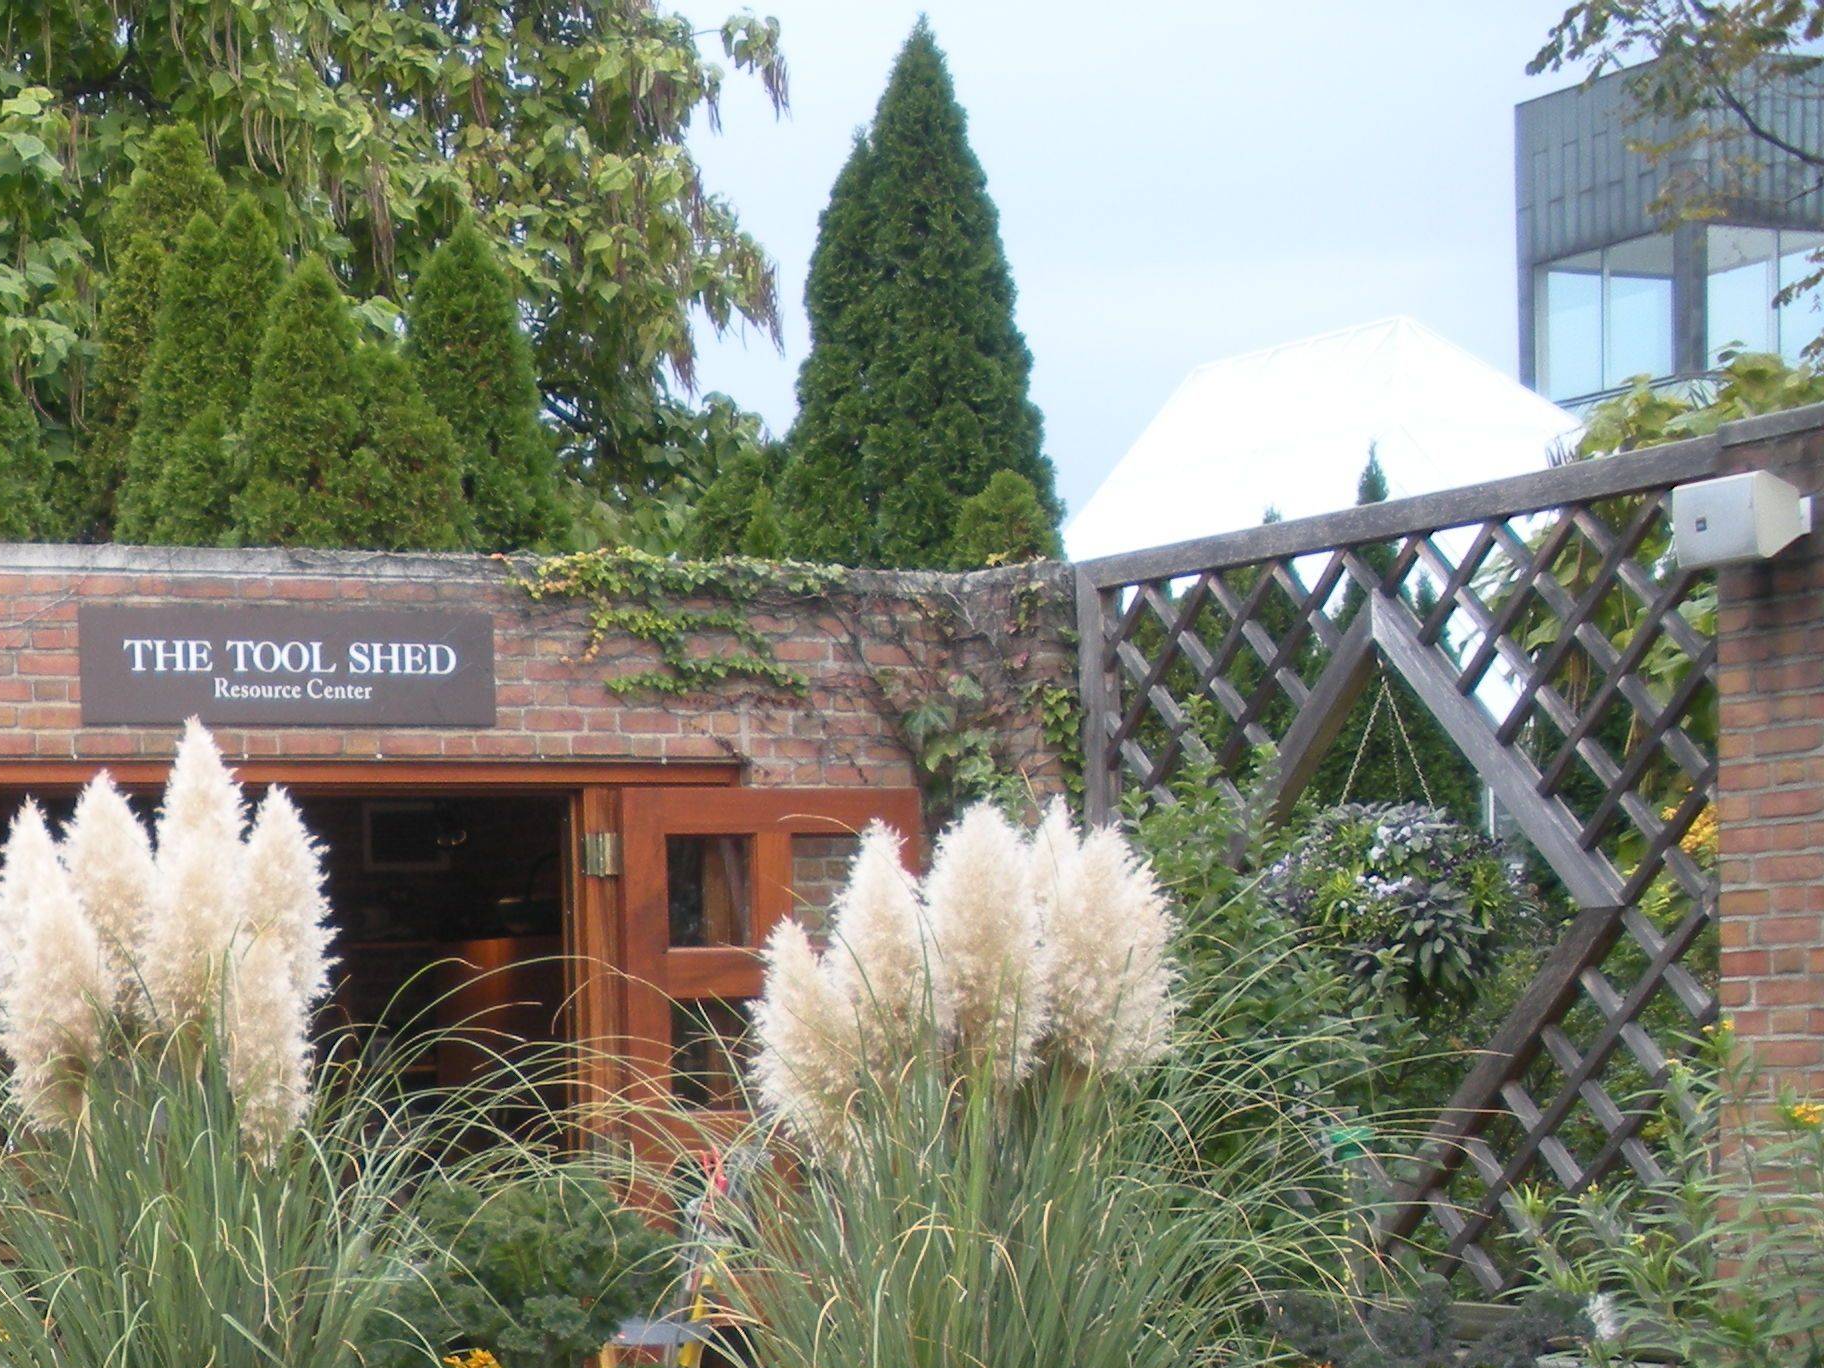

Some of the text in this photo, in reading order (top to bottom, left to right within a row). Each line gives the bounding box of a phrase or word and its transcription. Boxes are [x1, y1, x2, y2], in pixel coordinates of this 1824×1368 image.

[123, 638, 457, 676] THE TOOL SHED
[214, 677, 373, 701] Resource Center
